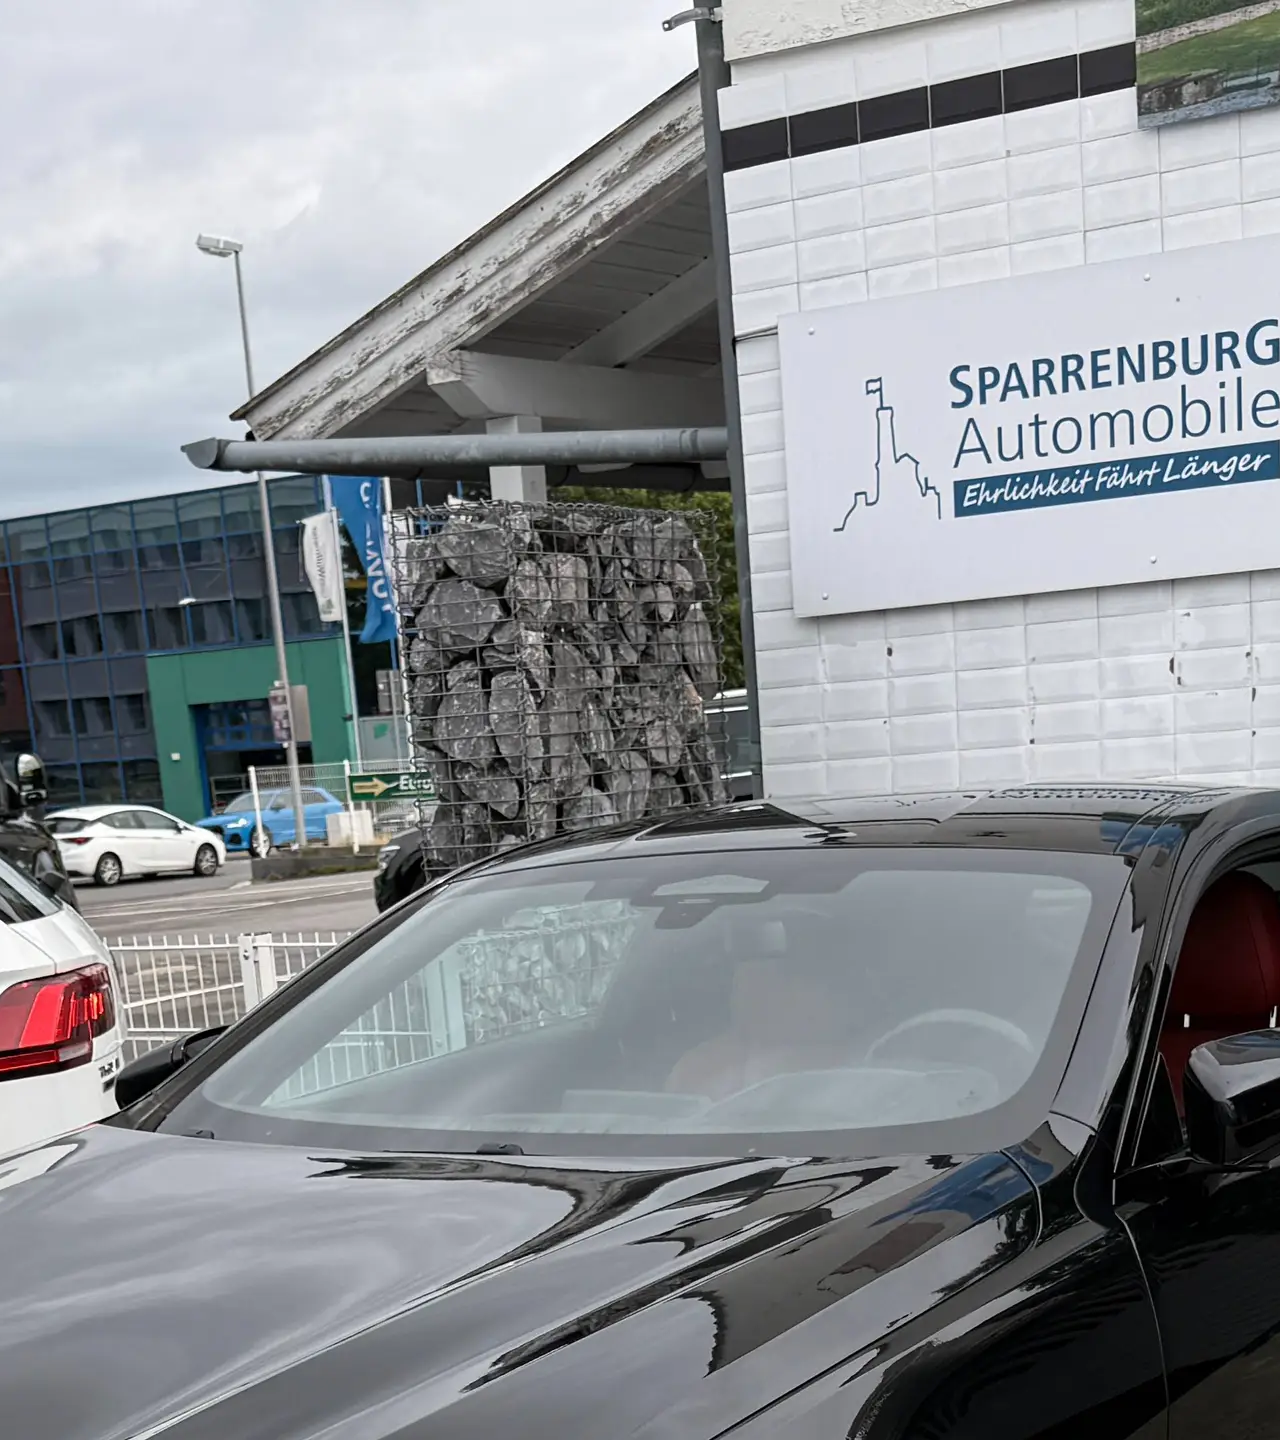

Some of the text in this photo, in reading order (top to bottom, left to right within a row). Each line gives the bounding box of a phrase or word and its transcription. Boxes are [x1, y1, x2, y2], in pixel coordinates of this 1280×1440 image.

[949, 319, 1280, 409] SPARRENBURG
[953, 376, 1280, 468] Automobile
[963, 453, 1271, 507] Ehrlichkeit Fährt Länger
